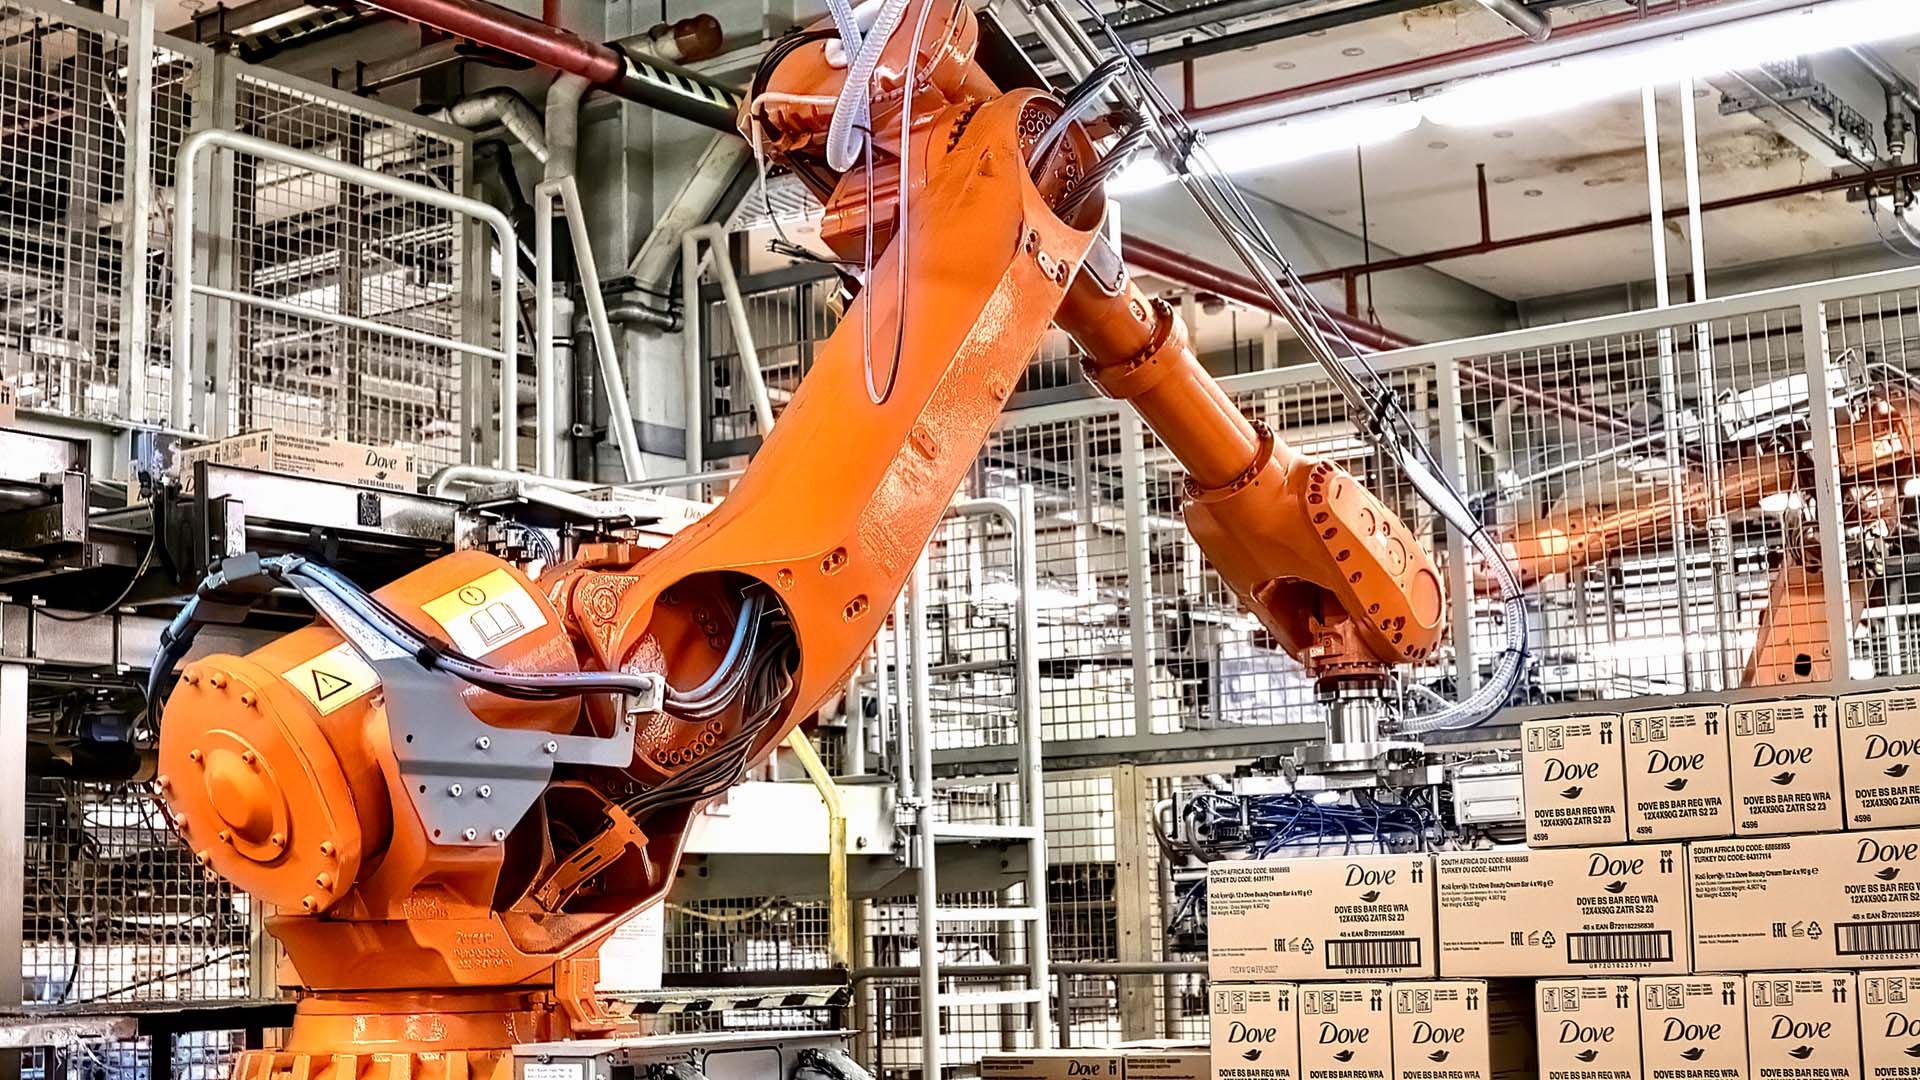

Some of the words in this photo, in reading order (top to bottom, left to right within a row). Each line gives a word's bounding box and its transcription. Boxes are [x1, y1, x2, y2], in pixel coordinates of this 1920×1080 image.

[365, 449, 397, 470] Dove
[1648, 750, 1704, 773] Dove
[1754, 743, 1813, 767] Dove
[1544, 758, 1599, 782] Dove
[1744, 795, 1763, 805] DOVE
[1766, 795, 1775, 803] BS
[1778, 794, 1793, 803] BAR
[1795, 793, 1810, 802] REG
[1813, 792, 1831, 801] WRA
[1855, 789, 1876, 798] DOVE
[1879, 788, 1889, 796] BS
[1891, 787, 1905, 796] BAR
[1909, 786, 1920, 795] RE
[1638, 801, 1657, 811] DOVE
[1660, 800, 1669, 809] BS
[1671, 799, 1686, 808] BAR
[1688, 798, 1702, 807] REG
[1705, 797, 1721, 806] WRA
[1749, 804, 1784, 814] 12X4X90G
[1786, 804, 1804, 812] ZATR
[1807, 803, 1815, 811] S2
[1818, 803, 1826, 811] 23
[1862, 797, 1897, 808] 12X4X90G
[1900, 796, 1920, 805] ZATR
[1535, 809, 1553, 818] DOVE
[1556, 808, 1564, 817] BS
[1566, 808, 1580, 816] BAR
[1583, 807, 1596, 815] REG
[1599, 806, 1615, 814] WRA
[1644, 810, 1677, 820] 12X4X90G
[1680, 809, 1697, 818] ZATR
[1699, 808, 1707, 816] S2
[1710, 808, 1717, 816] 23
[1540, 817, 1572, 827] 12X4X90G
[1574, 816, 1591, 825] ZATR
[1857, 838, 1918, 863] Dove
[1588, 853, 1644, 876] Dove
[1345, 864, 1396, 886] Dove
[1845, 885, 1865, 894] DOVE
[1868, 884, 1878, 893] BS
[1880, 884, 1896, 892] BAR
[1898, 883, 1915, 892] REG
[1577, 897, 1595, 905] DOVE
[1598, 896, 1606, 905] BS
[1609, 896, 1623, 904] BAR
[1625, 896, 1639, 904] REG
[1642, 895, 1658, 904] WRA
[1850, 894, 1886, 903] 12X4X90G
[1889, 893, 1908, 902] ZATR
[1910, 893, 1920, 901] S2
[1582, 906, 1614, 915] 12X4X90G
[1617, 906, 1633, 914] ZATR
[1636, 905, 1643, 913] S2
[1646, 905, 1654, 913] 23
[1339, 915, 1368, 923] 12X4X90G
[1664, 1017, 1721, 1041] Dove
[1771, 1015, 1831, 1039] Dove
[1885, 1012, 1920, 1037] Do
[1228, 1021, 1276, 1043] Dove
[1319, 1022, 1369, 1044] Dove
[1413, 1021, 1464, 1044] Dove
[1560, 1020, 1614, 1043] Dove
[1068, 1060, 1100, 1076] Dove
[1654, 1070, 1673, 1078] DOVE
[1676, 1070, 1685, 1078] BS
[1760, 1069, 1781, 1077] DOVE
[1783, 1069, 1793, 1077] BS
[1796, 1069, 1811, 1077] BAR
[1813, 1068, 1828, 1076] REG
[1831, 1068, 1849, 1076] WRA
[1875, 1067, 1896, 1076] DOVE
[1898, 1067, 1909, 1076] BS
[1911, 1067, 1920, 1076] BA
[1550, 1071, 1568, 1079] DOVE
[1571, 1071, 1579, 1079] BS
[1598, 1071, 1612, 1079] REG
